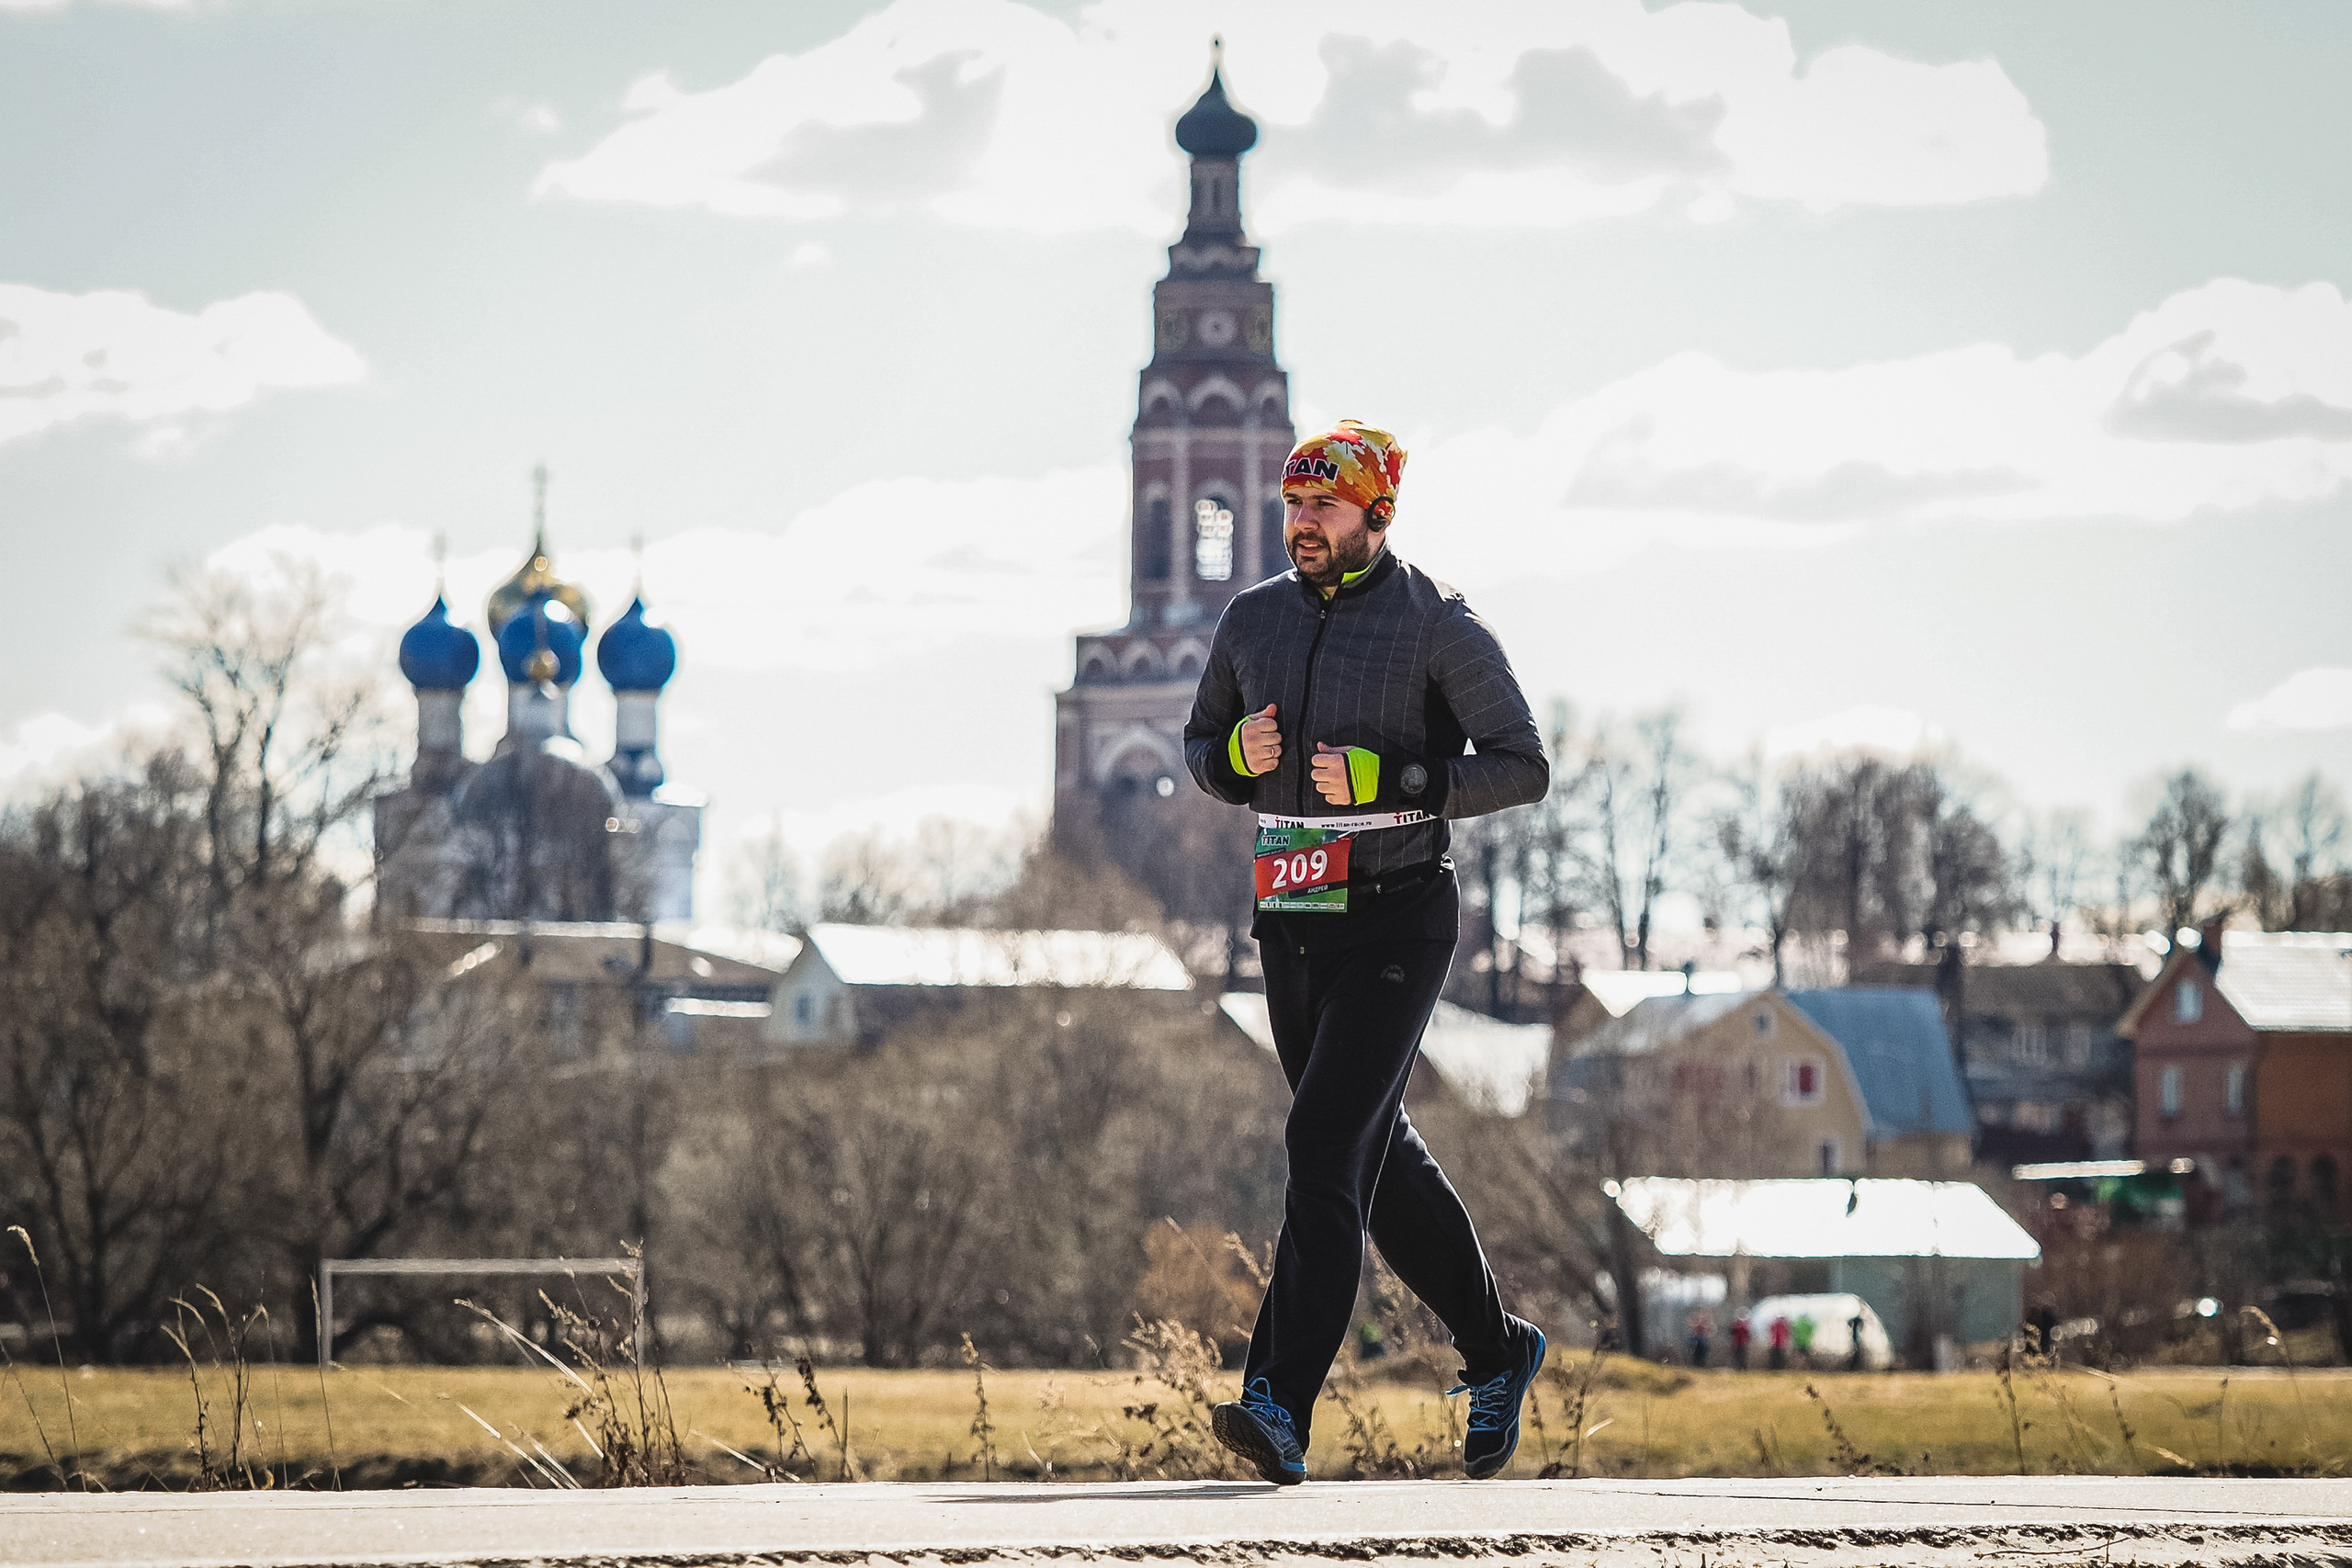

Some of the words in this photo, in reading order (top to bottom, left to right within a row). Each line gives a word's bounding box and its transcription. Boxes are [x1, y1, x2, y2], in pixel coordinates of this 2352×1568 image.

[1283, 457, 1339, 482] TAN
[1275, 817, 1305, 829] TITAN
[1261, 835, 1290, 846] TITAN
[1272, 849, 1329, 890] 209
